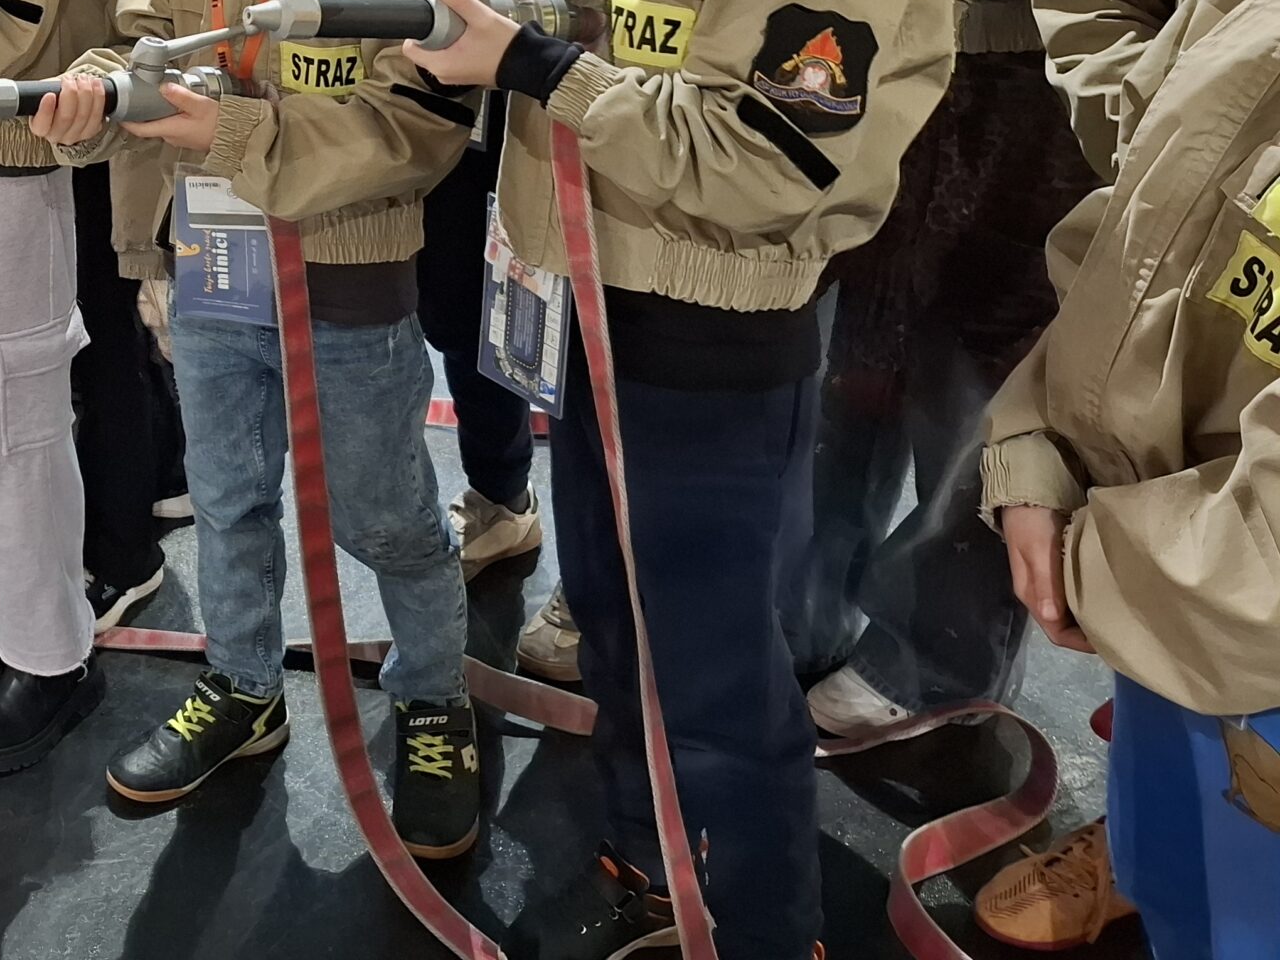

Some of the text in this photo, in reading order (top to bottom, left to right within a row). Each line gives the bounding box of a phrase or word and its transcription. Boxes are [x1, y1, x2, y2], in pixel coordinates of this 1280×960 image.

[291, 52, 358, 88] STRAZ
[194, 679, 222, 702] LOTTO
[408, 714, 449, 727] LOTTO
